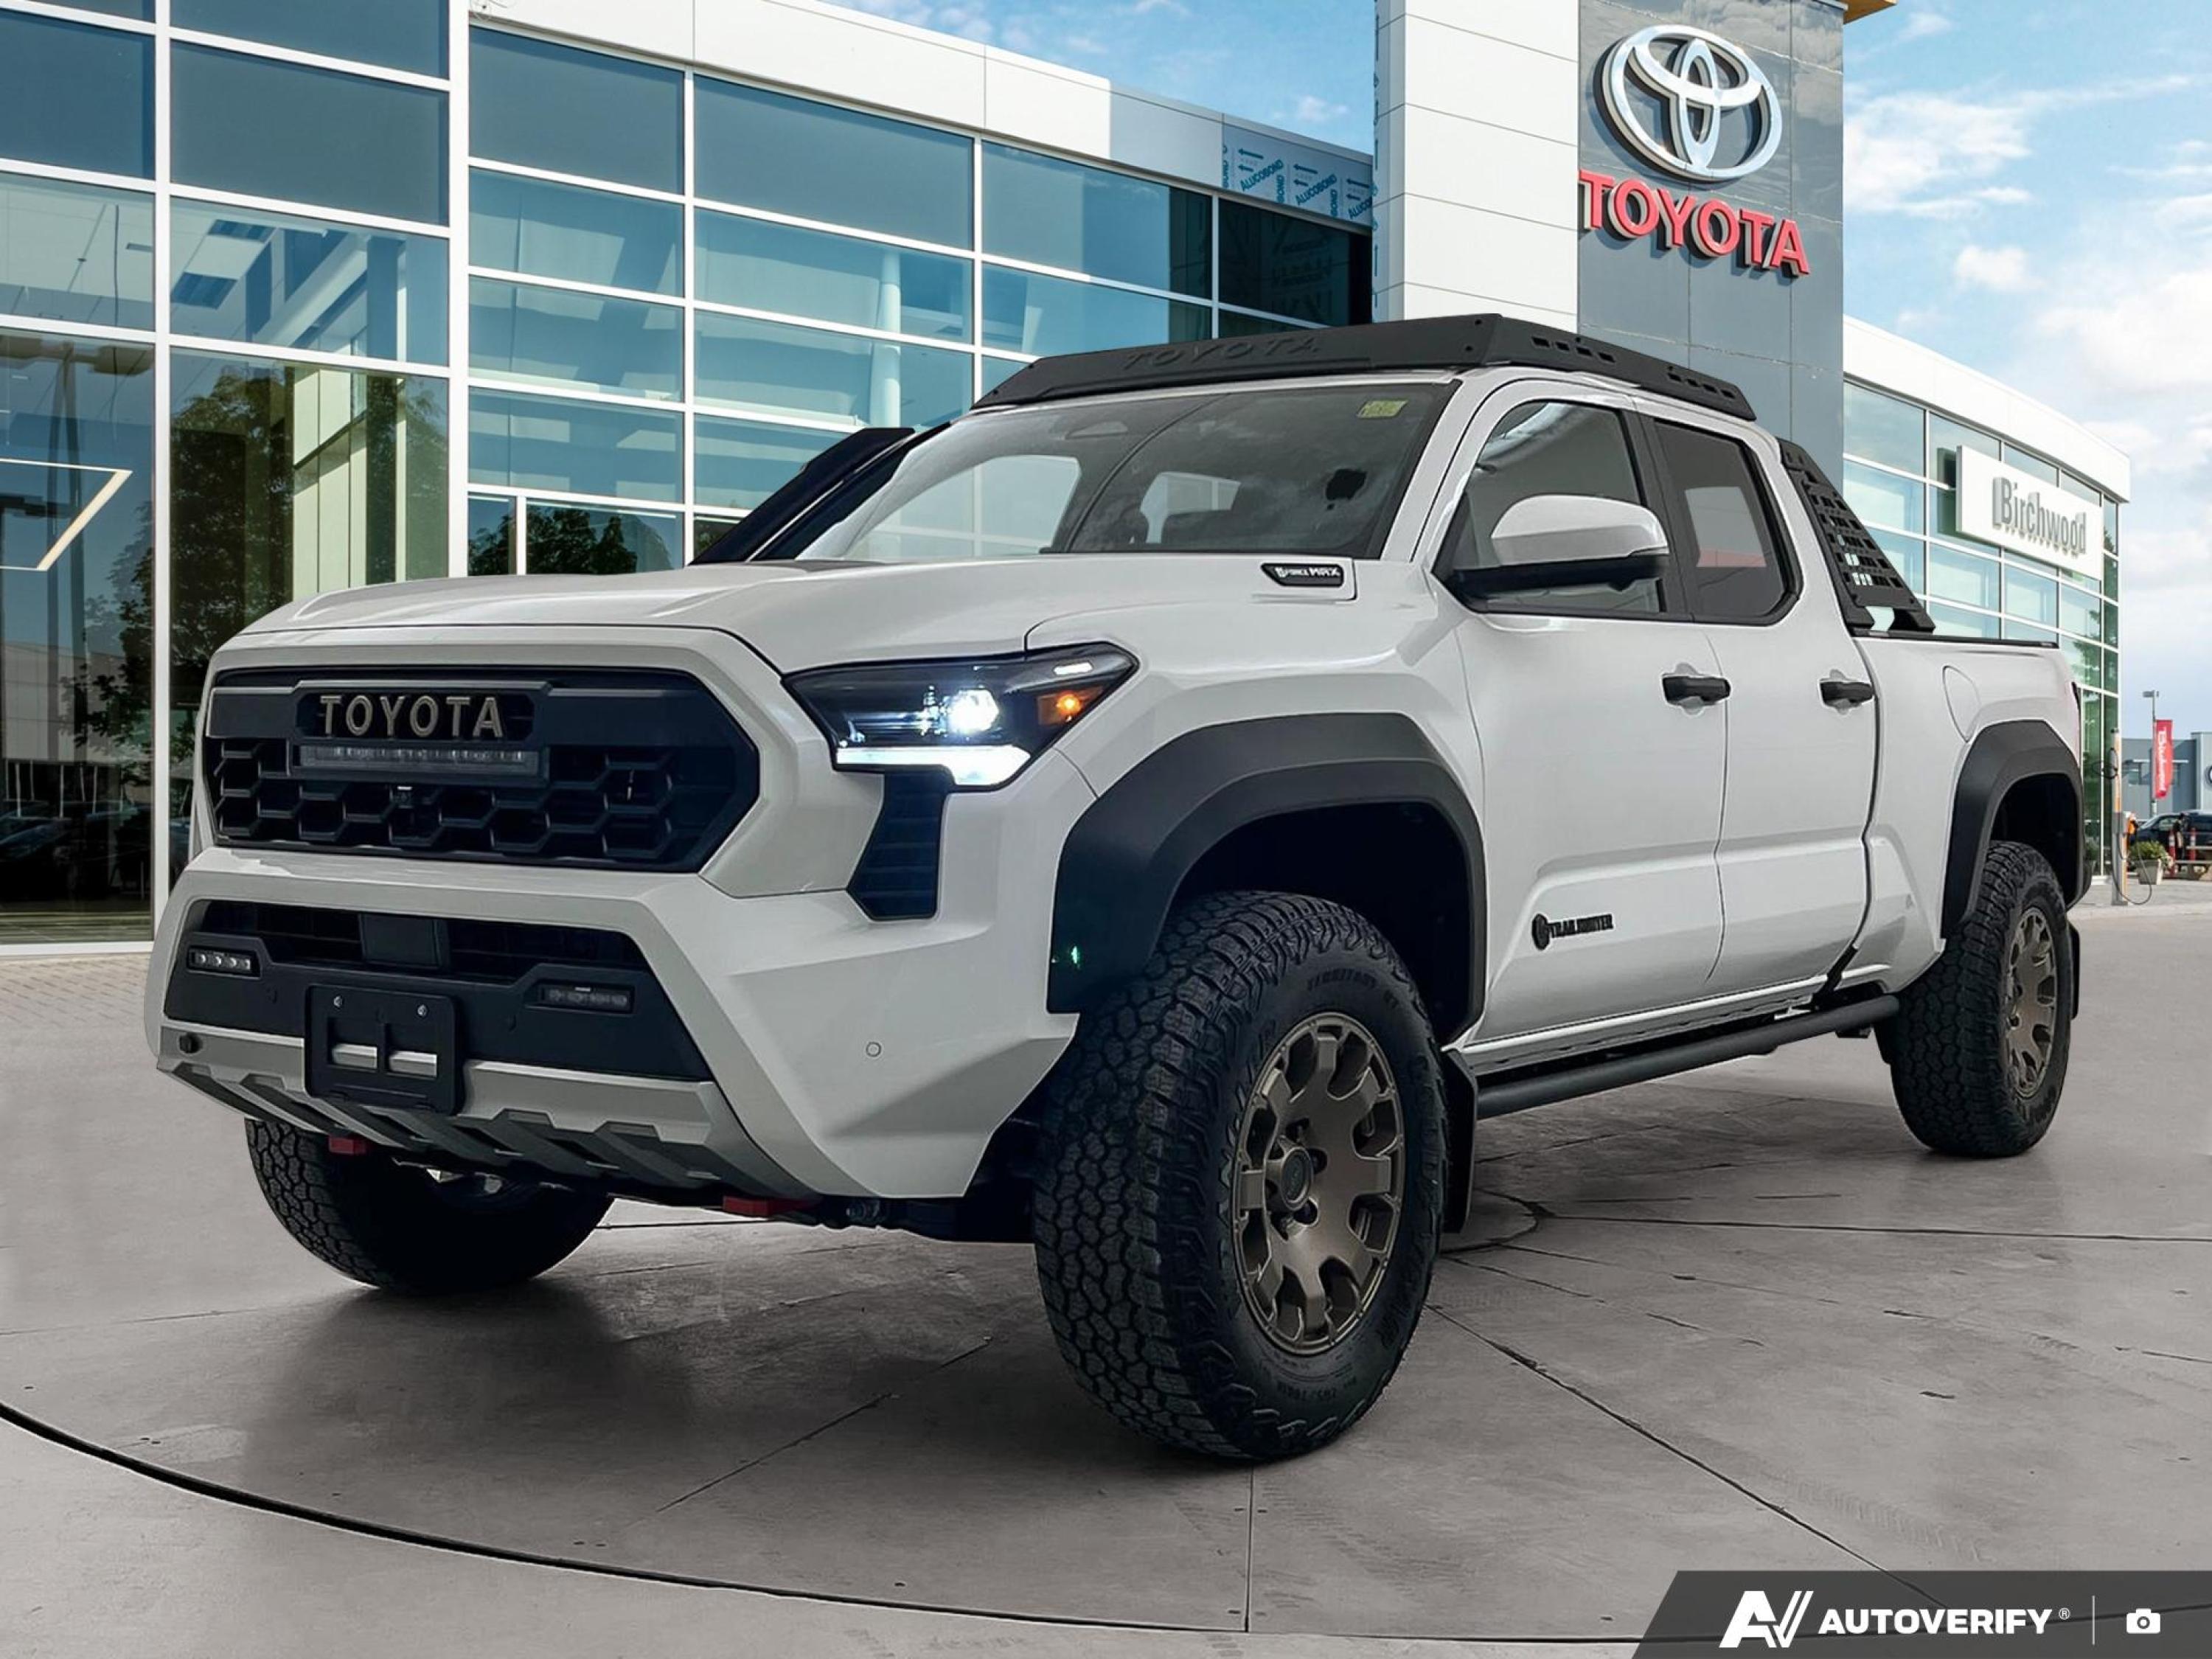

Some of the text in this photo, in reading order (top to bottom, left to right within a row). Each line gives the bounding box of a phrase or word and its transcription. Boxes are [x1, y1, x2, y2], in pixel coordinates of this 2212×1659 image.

[1240, 159, 1284, 192] ALUCOBOND
[1295, 174, 1337, 206] ALUCOBOND
[1579, 170, 1810, 276] TOYOTA
[1124, 336, 1319, 369] TOYOTA
[1993, 476, 2087, 558] Birchwood
[320, 695, 504, 738] TOYOTA
